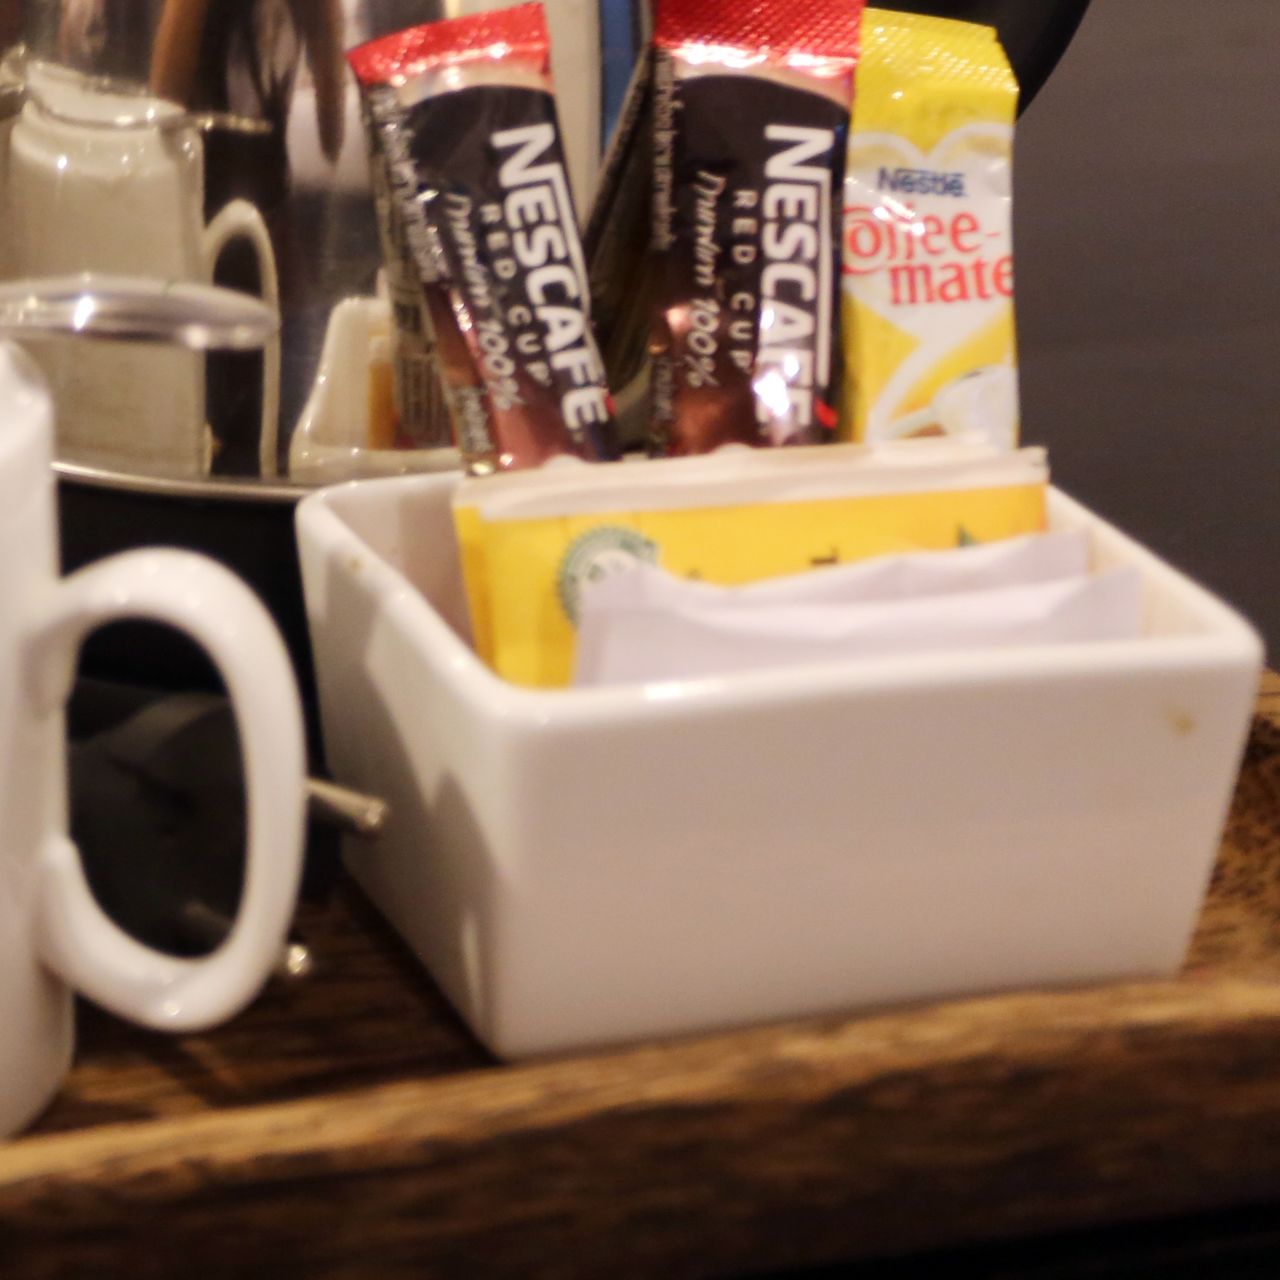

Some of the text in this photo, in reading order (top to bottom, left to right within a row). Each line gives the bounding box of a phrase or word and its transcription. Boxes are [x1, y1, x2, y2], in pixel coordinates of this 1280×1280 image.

[479, 202, 553, 389] RED CUP
[686, 298, 720, 389] 100%
[728, 189, 758, 370] RED CUP
[891, 254, 1014, 306] mate
